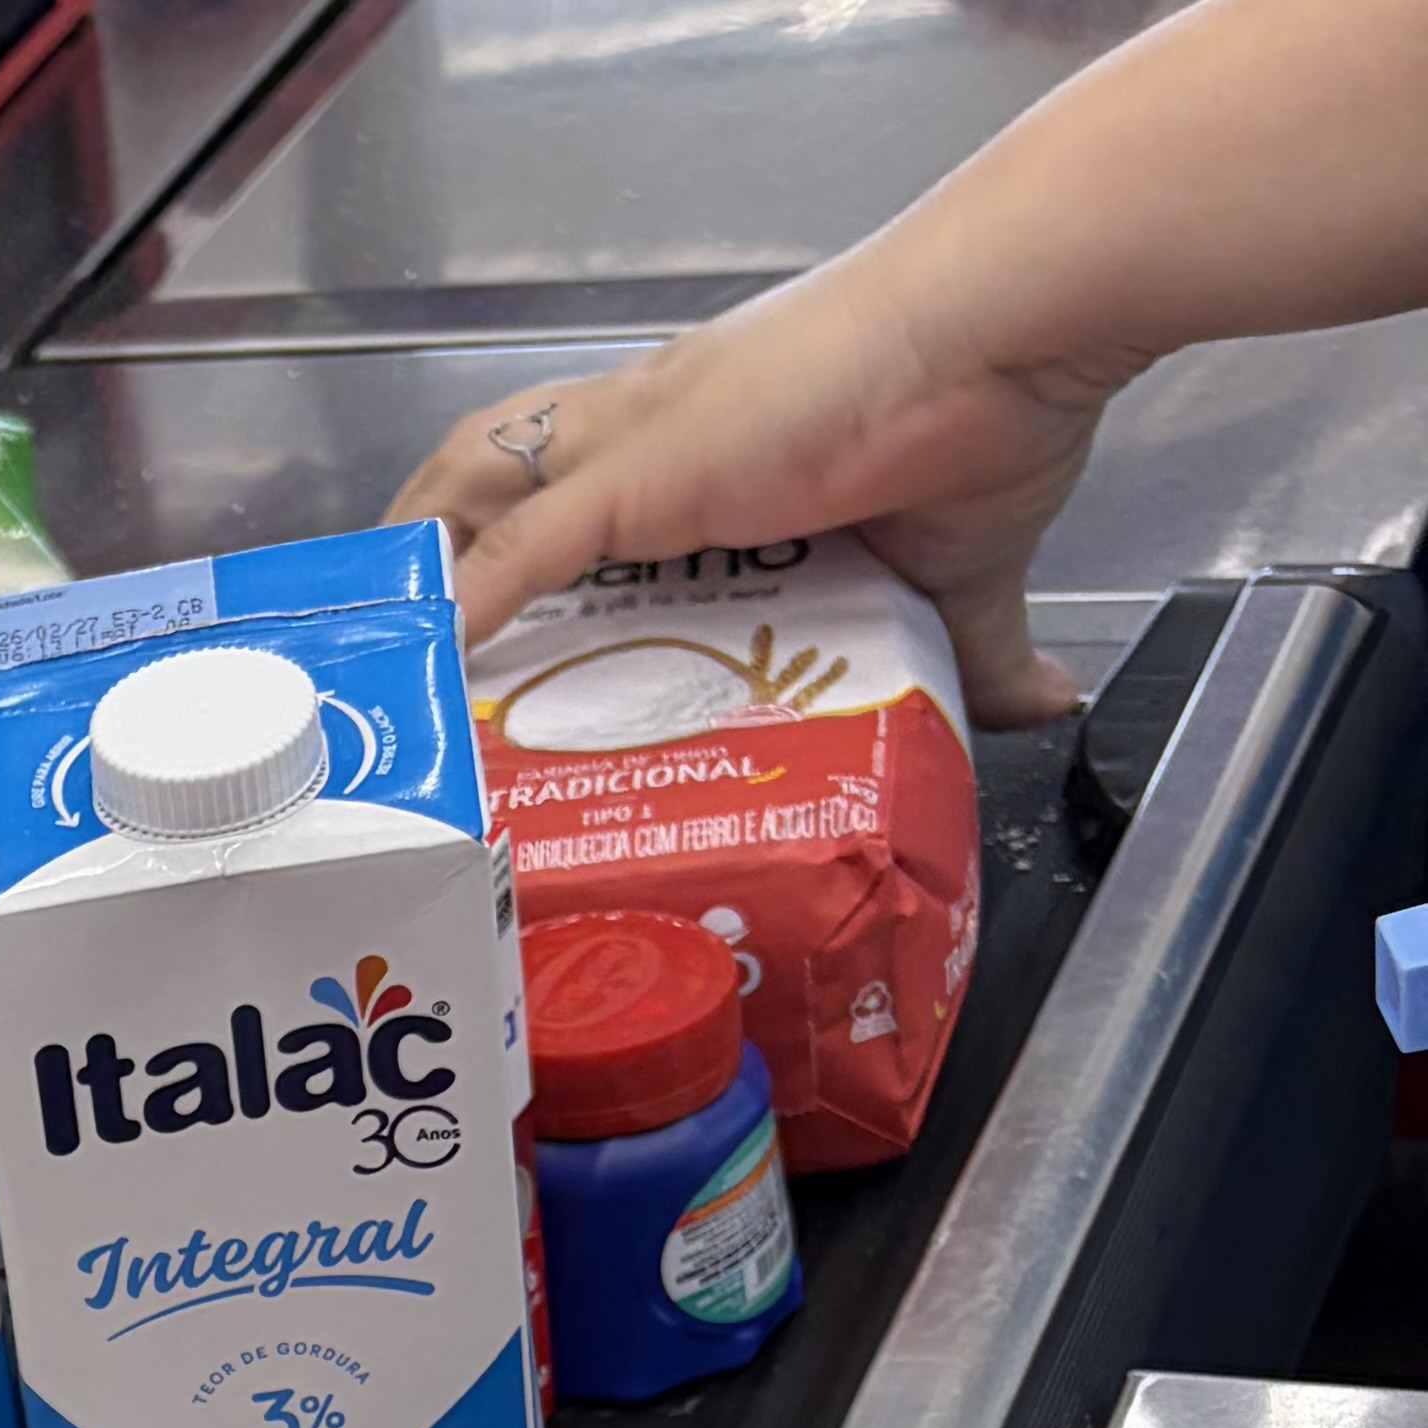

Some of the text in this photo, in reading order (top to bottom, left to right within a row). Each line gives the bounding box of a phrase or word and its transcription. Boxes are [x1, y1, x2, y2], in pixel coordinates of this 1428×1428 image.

[489, 755, 760, 812] TRADICIONAL
[516, 807, 758, 873] ENRIQUECIDA COM FERRO E
[35, 1004, 456, 1157] Italac
[415, 1126, 462, 1143] Anos
[77, 1198, 436, 1311] Integral
[192, 1341, 371, 1406] TEOR DE GORDURA
